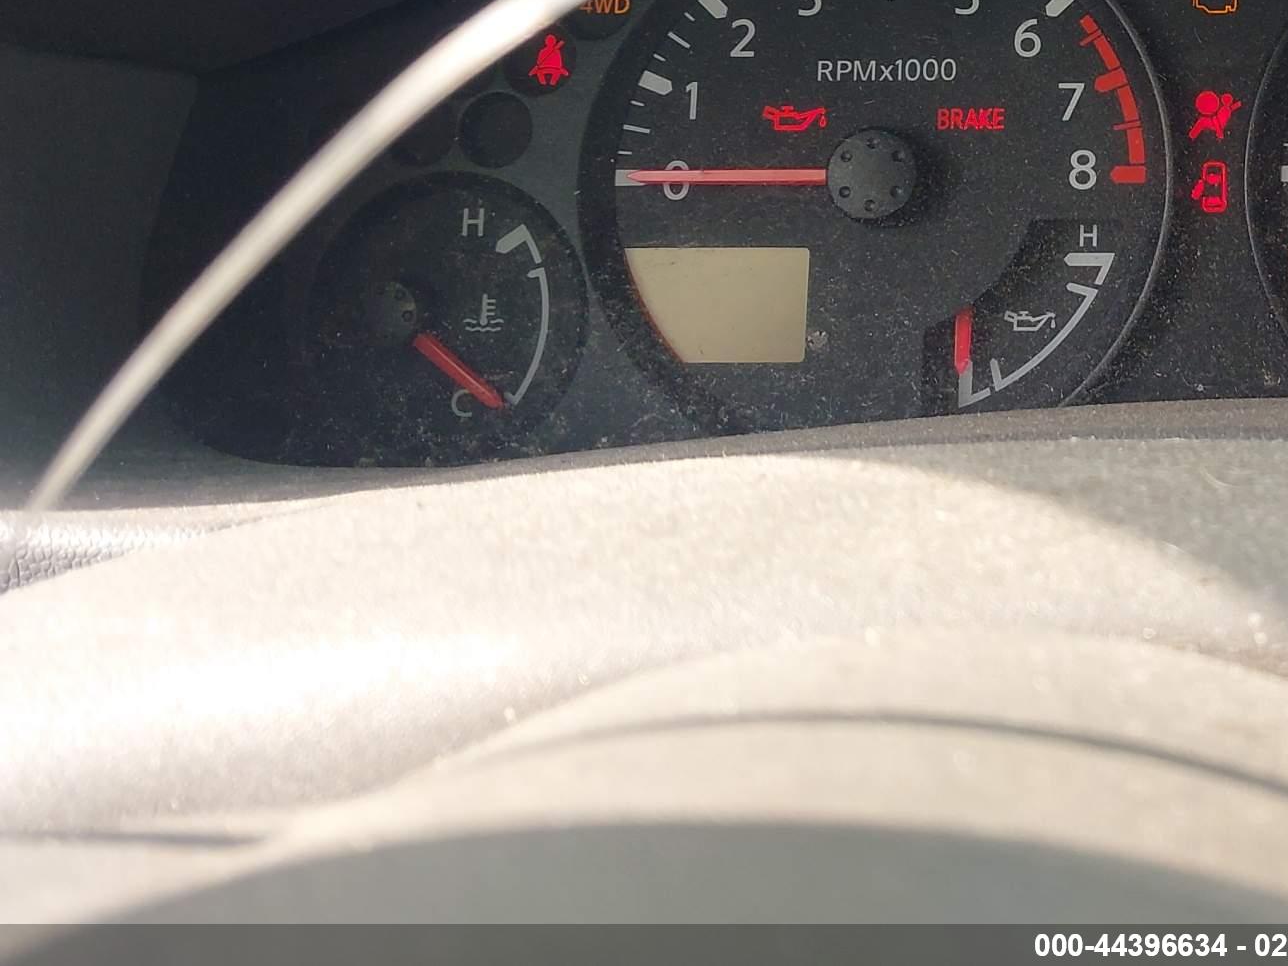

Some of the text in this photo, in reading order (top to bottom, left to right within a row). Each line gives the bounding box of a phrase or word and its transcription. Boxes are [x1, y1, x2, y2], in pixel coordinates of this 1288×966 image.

[730, 19, 755, 57] 2
[1013, 19, 1042, 57] 6
[816, 58, 957, 82] RPMx1000
[685, 81, 697, 119] 1
[1058, 83, 1084, 121] 7
[937, 108, 1005, 131] BRAKE
[663, 160, 690, 201] 0
[1068, 150, 1098, 190] 8
[462, 208, 484, 236] H
[1079, 225, 1098, 247] H
[451, 389, 473, 417] C
